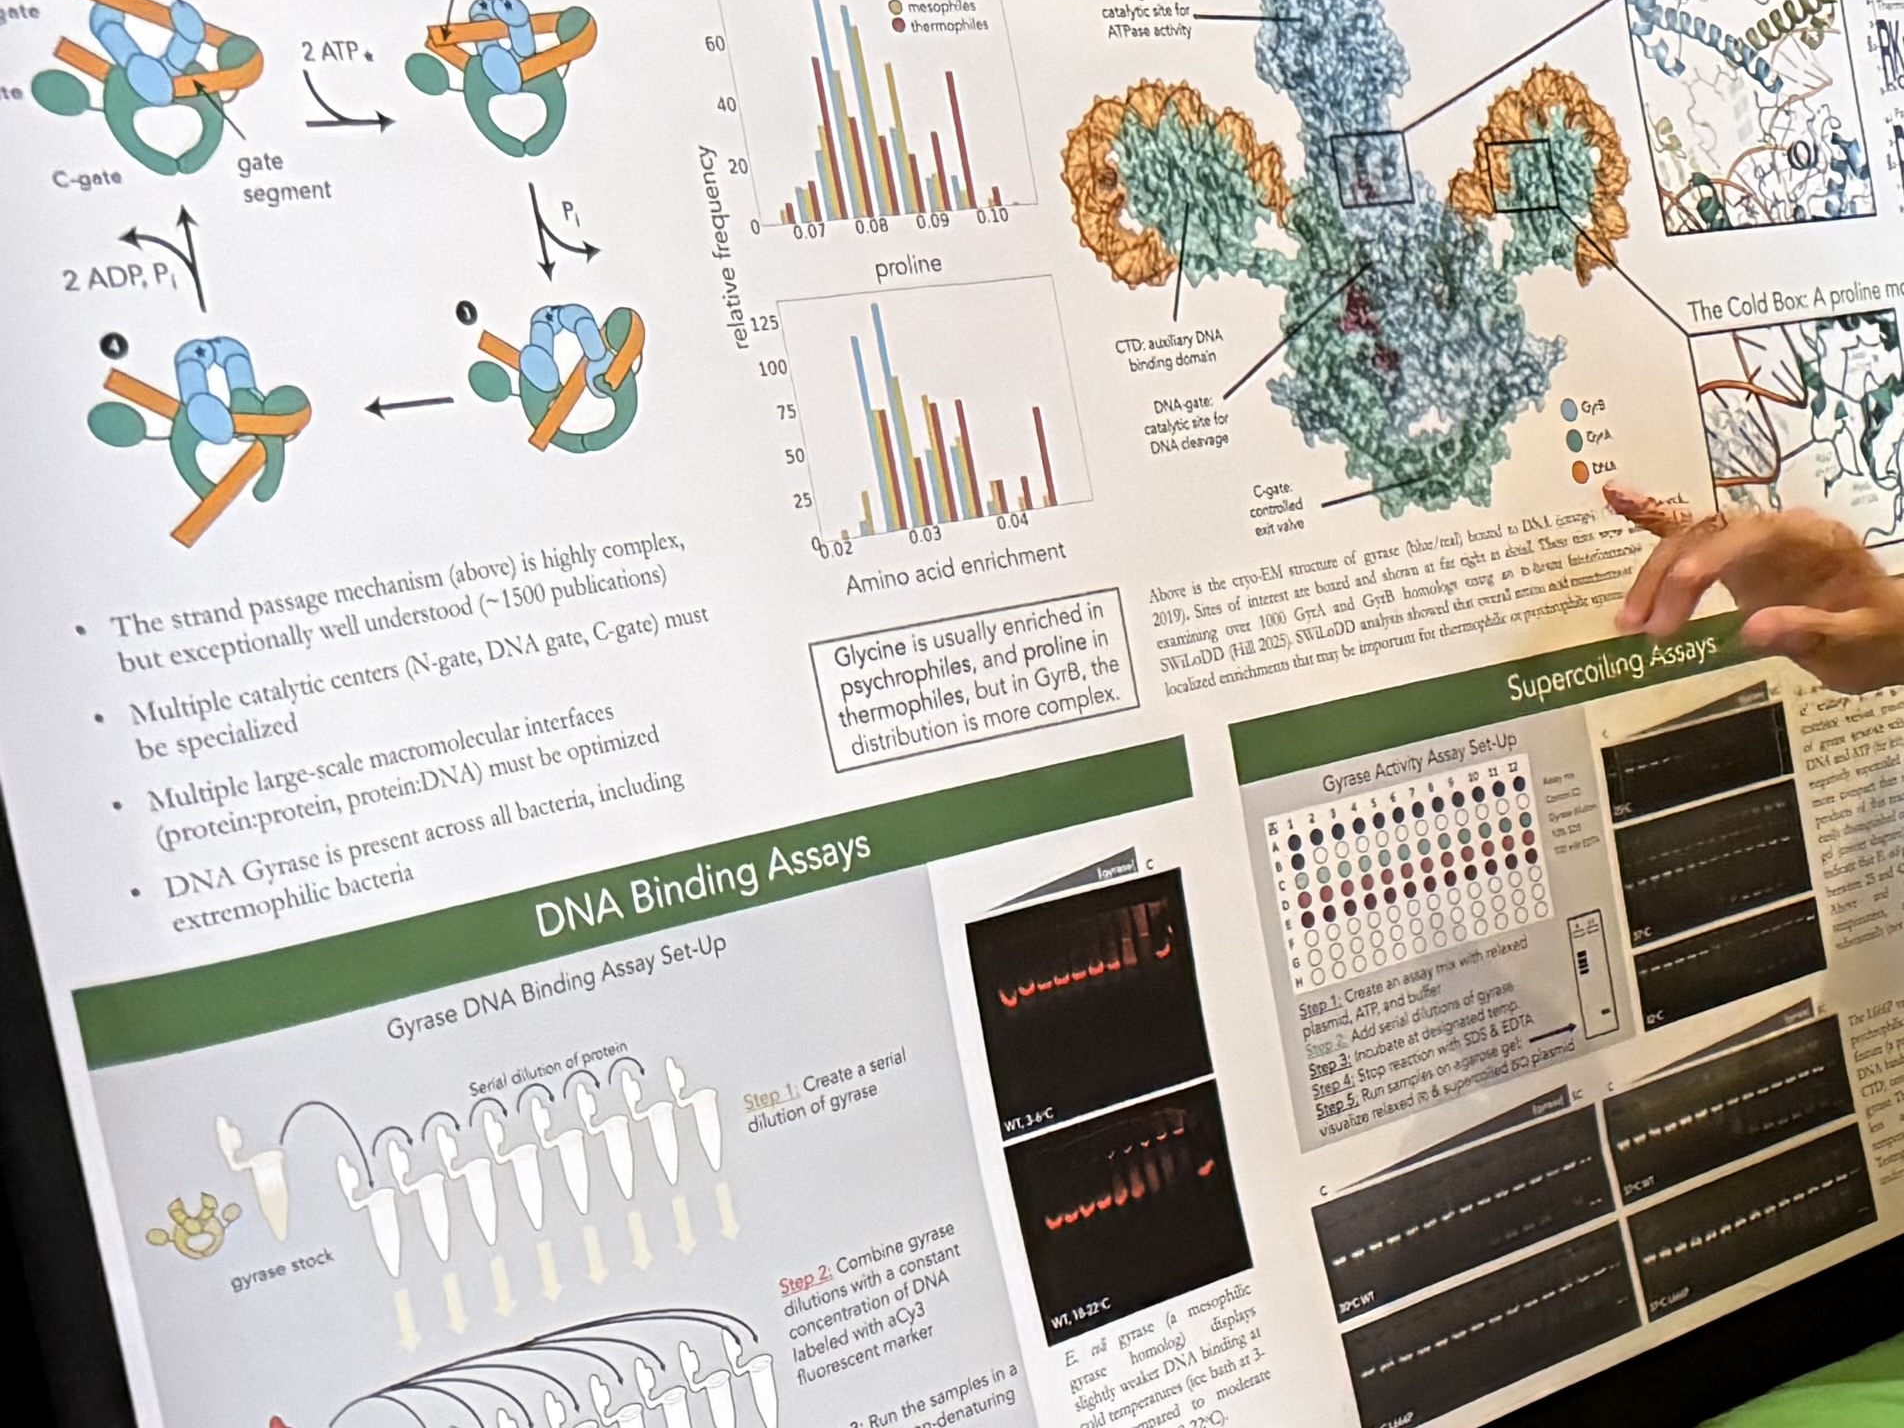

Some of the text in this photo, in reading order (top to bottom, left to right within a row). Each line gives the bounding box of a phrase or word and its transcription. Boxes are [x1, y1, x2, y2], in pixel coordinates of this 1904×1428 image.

[301, 40, 359, 62] 2 ATP
[698, 145, 751, 349] relative frequency
[875, 253, 943, 281] proline
[1686, 299, 1724, 323] The
[1726, 291, 1769, 318] Cold
[1771, 291, 1809, 312] Box:
[1813, 286, 1827, 307] A
[1829, 281, 1881, 312] proline
[109, 531, 685, 638] The strand passage mechanism (above) is highly complex,
[846, 542, 1067, 596] Amino acid enrichment
[116, 651, 164, 673] but
[169, 623, 313, 666] exceptionally
[318, 613, 361, 640] well
[364, 594, 474, 632] understood
[550, 563, 667, 608] publications)
[834, 601, 1104, 670] Glycine is usually enriched in
[838, 655, 1120, 728] thermophiles, but in GyrB, the
[840, 632, 1109, 704] psychrophiles, and proline in
[1507, 636, 1718, 704] Supercoiling Assays
[851, 686, 1121, 756] distribution is more complex.
[535, 835, 871, 938] DNA Binding Assays
[386, 934, 727, 1042] Gyrase DNA Binding Assay Set-Up
